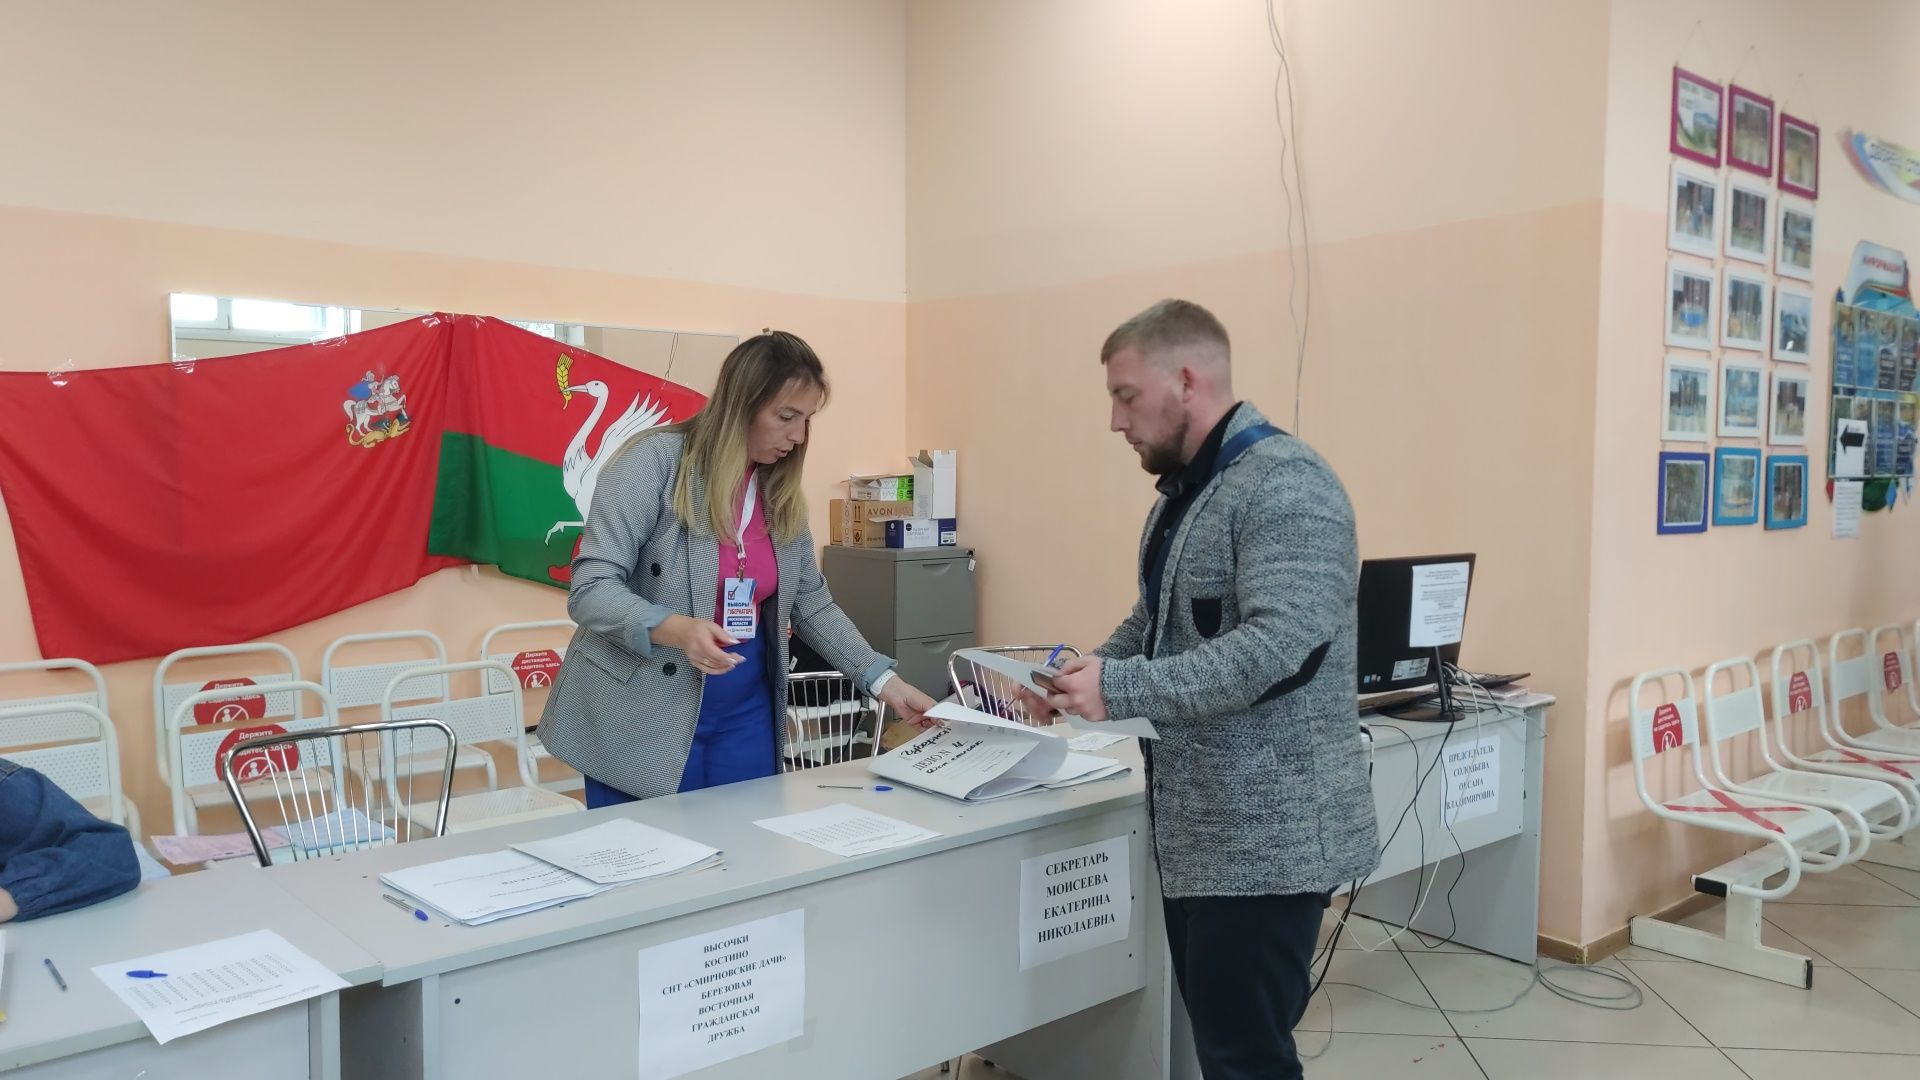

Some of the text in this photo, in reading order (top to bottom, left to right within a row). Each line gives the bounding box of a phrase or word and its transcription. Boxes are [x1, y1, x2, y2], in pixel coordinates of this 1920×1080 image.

[867, 508, 893, 516] AVON
[239, 730, 273, 740] Держите
[1045, 852, 1109, 876] СЕКРЕТАРЬ
[1046, 873, 1109, 898] МОИСЕЕВА
[1044, 893, 1111, 920] ЕКАТЕРИНА
[1038, 913, 1115, 943] НИКОЛАЕВНА
[703, 934, 749, 954] ВЫСОЧКИ
[704, 950, 749, 969] КОСТИНО
[662, 954, 787, 996] СНТ «СМИРНОВСКИЕ ДАЧИ»
[701, 978, 752, 1000] БЕРЕЗОВАЯ
[698, 993, 754, 1015] ВОСТОЧНАЯ
[692, 1006, 760, 1032] ГРАЖДАНСКАЯ
[707, 1026, 745, 1044] ДРУЖБА
